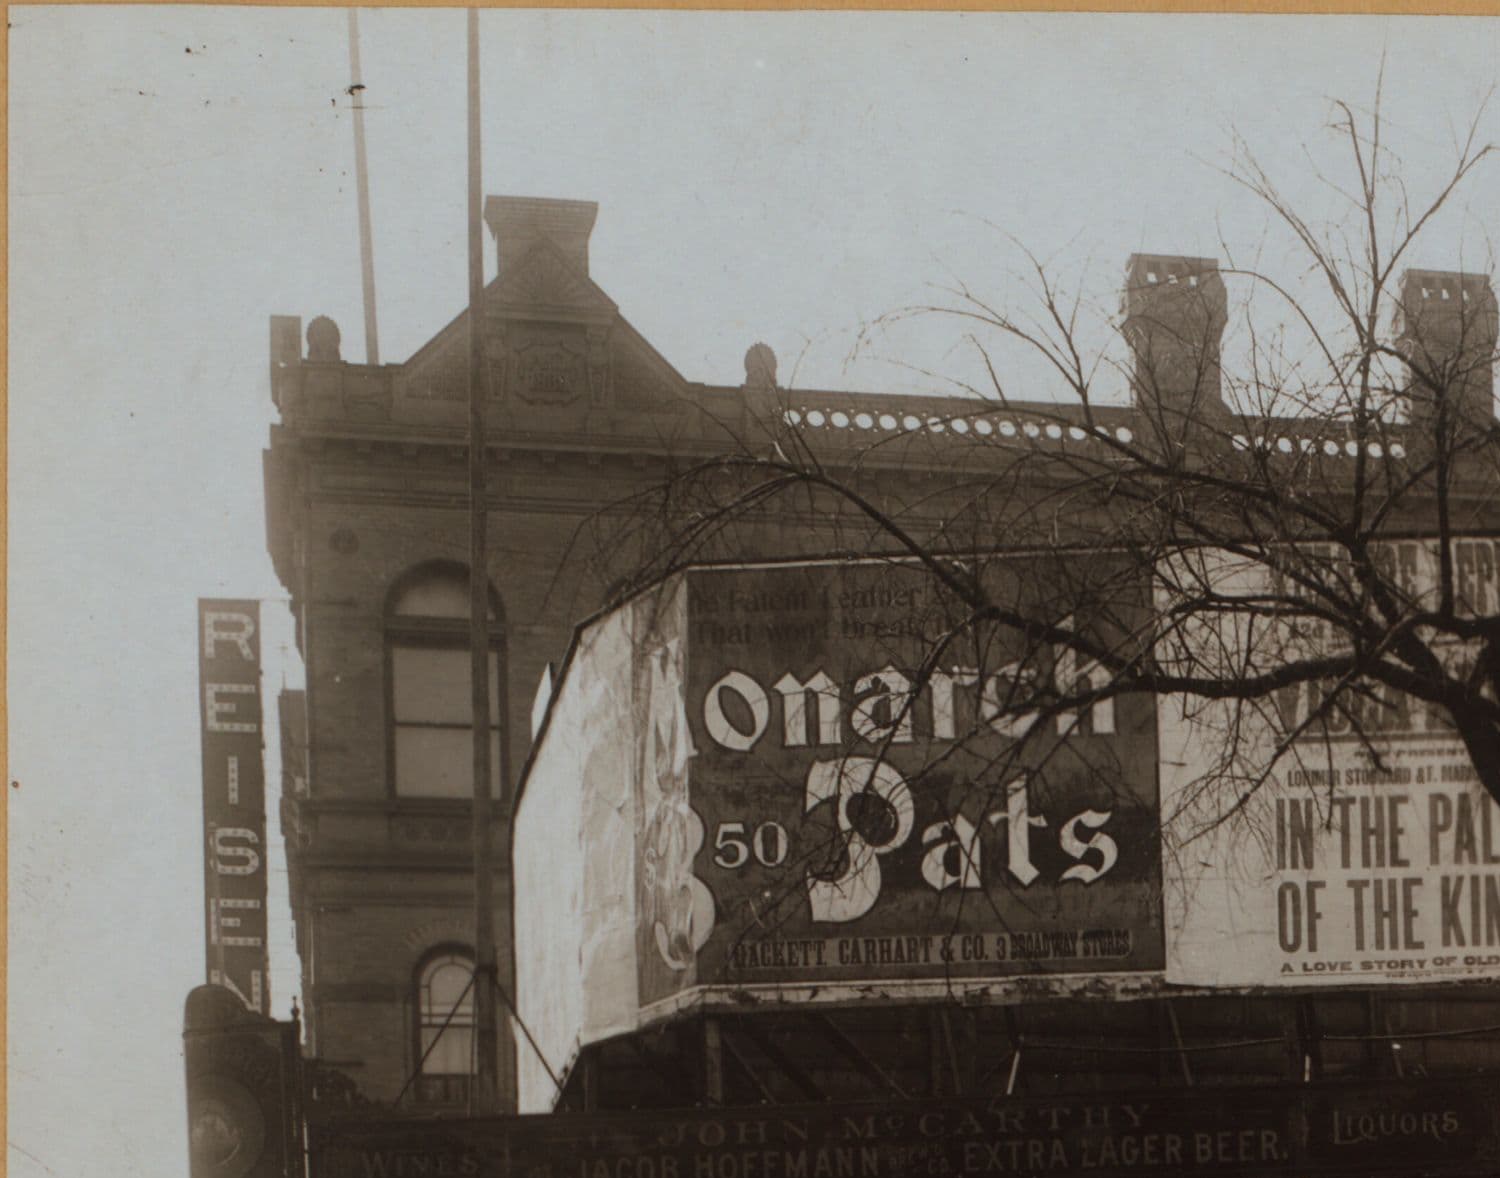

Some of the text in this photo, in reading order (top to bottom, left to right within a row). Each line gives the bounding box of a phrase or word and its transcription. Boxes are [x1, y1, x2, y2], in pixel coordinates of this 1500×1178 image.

[714, 820, 788, 868] 50
[806, 756, 1119, 923] Pats
[1275, 798, 1315, 871] IN
[1332, 795, 1410, 870] THE
[1277, 880, 1327, 953] OF
[1347, 877, 1425, 952] THE
[837, 936, 933, 964] CARHART
[939, 936, 955, 962] &
[961, 934, 989, 961] CO.
[1280, 961, 1296, 975] A
[1301, 958, 1353, 974] LOVE
[1359, 957, 1428, 972] STORY
[1431, 955, 1458, 968] OF
[1463, 954, 1500, 967] OLD
[658, 1118, 810, 1147] JOHN
[1332, 1110, 1460, 1145] LIQUORS
[964, 1137, 1069, 1172] EXTRA
[1080, 1133, 1183, 1169] LAGER
[1193, 1129, 1289, 1165] BEER.
